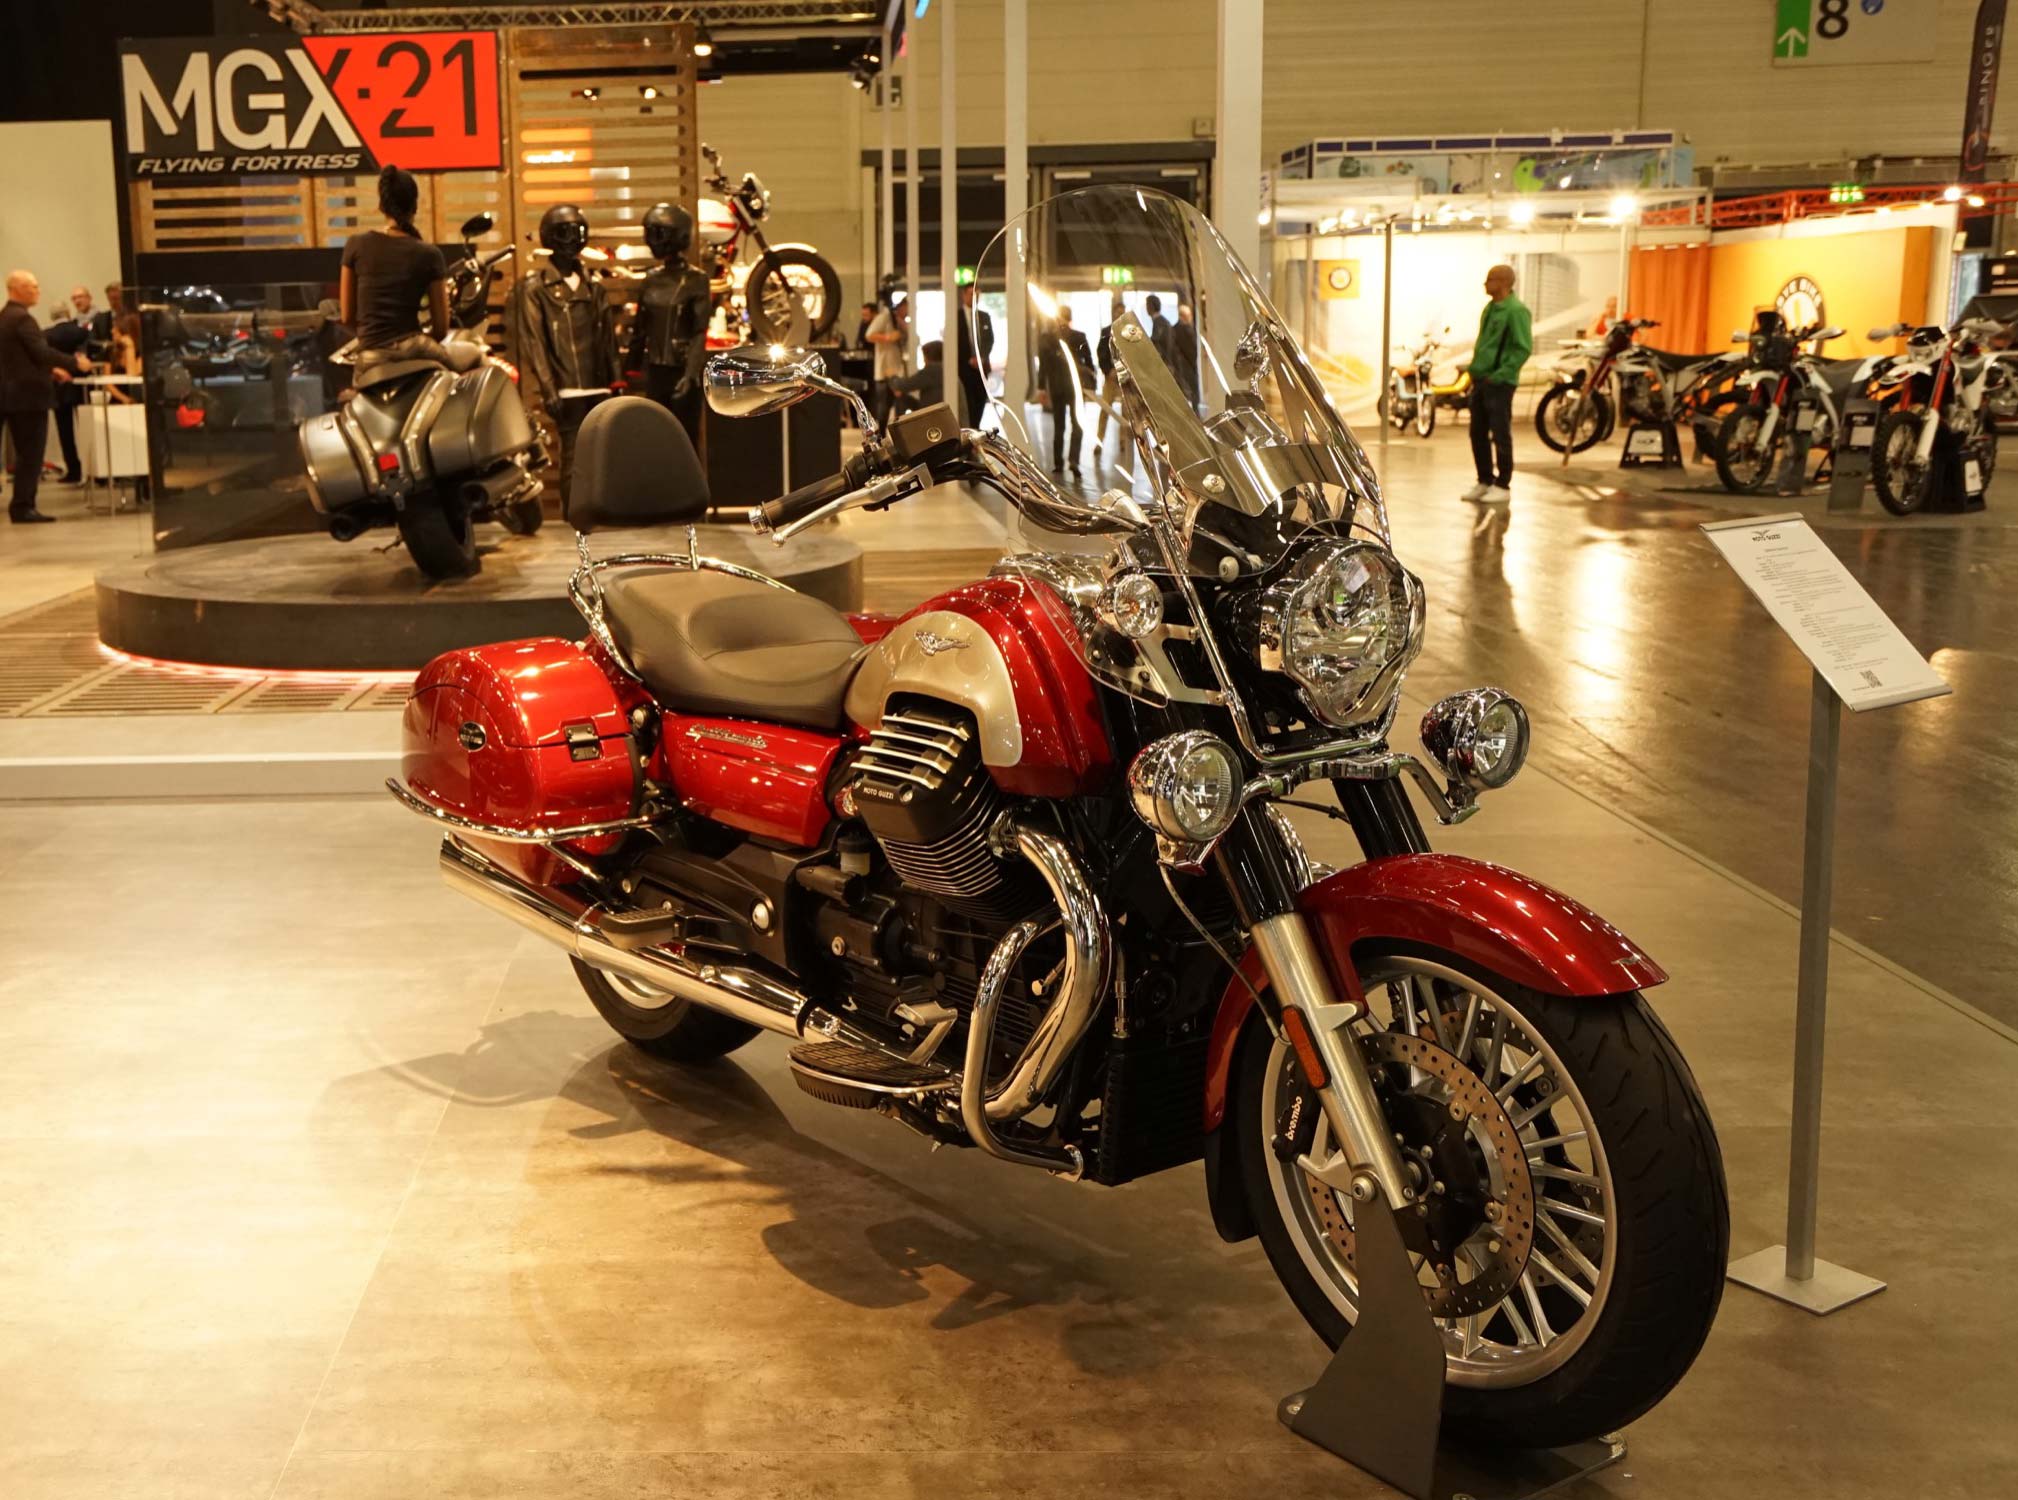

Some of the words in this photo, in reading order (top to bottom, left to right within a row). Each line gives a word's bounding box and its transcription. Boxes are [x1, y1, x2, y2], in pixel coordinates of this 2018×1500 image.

[1816, 0, 1849, 39] 8
[137, 157, 225, 174] FLYING
[230, 153, 361, 172] FORTRESS
[863, 786, 878, 796] MOTO
[1285, 1095, 1303, 1141] brembo
